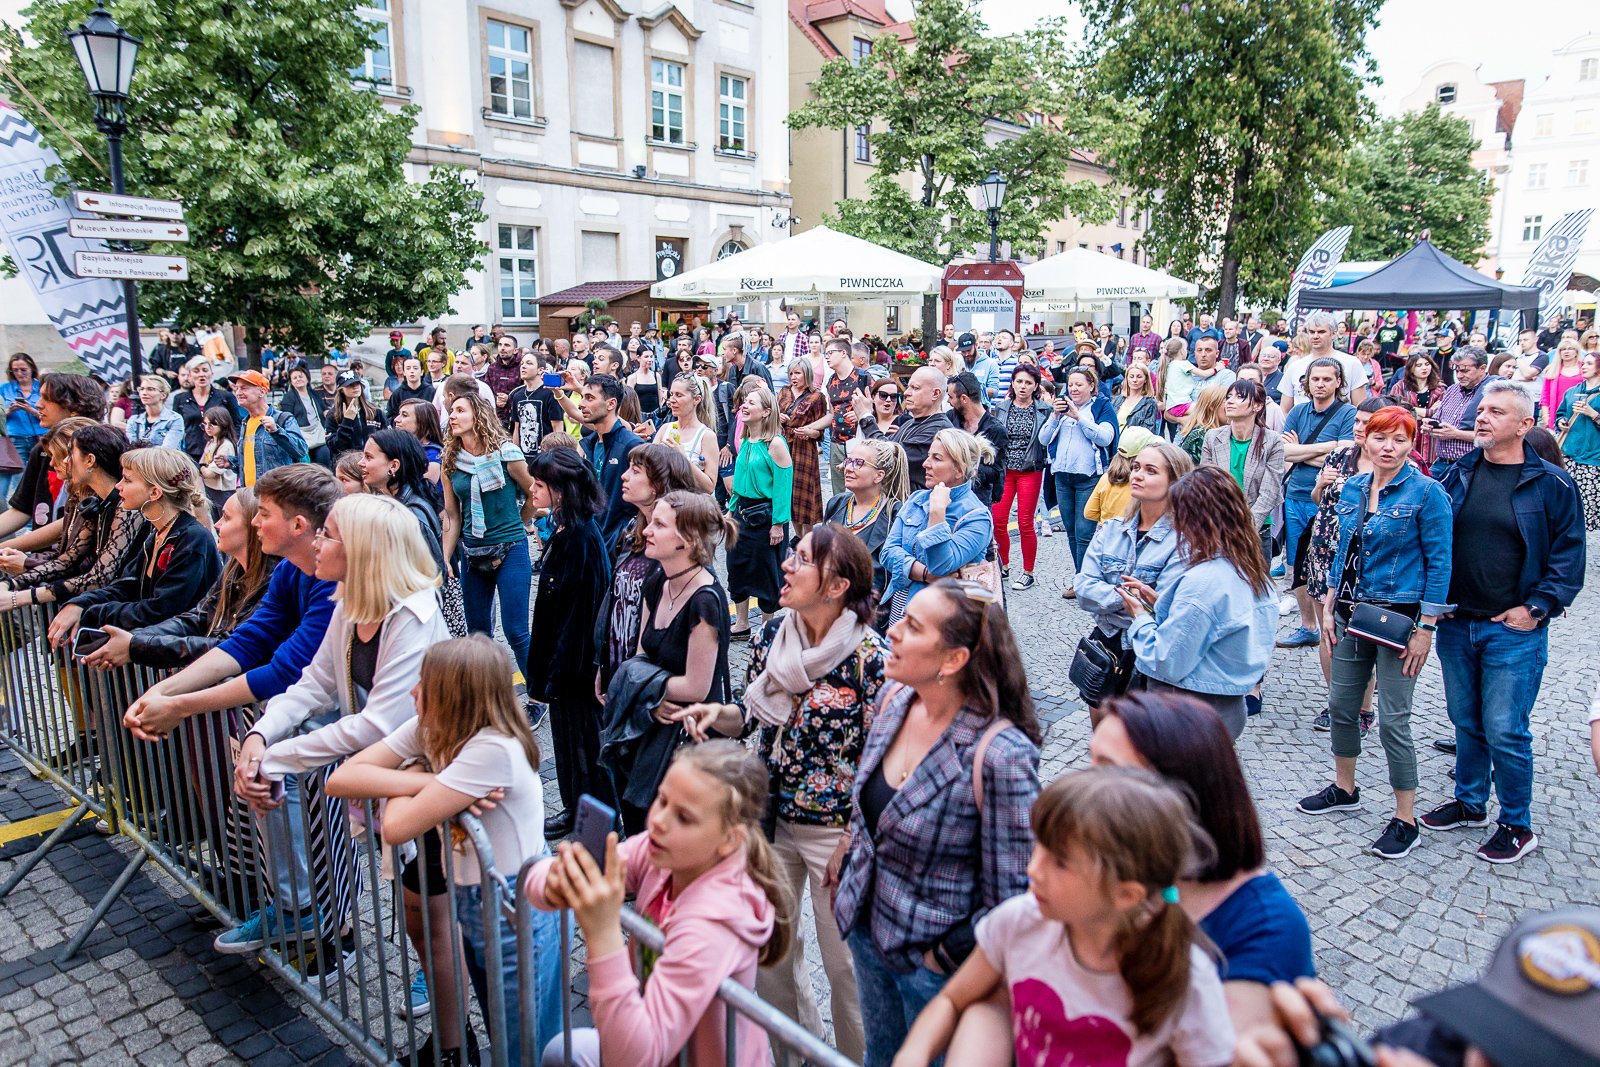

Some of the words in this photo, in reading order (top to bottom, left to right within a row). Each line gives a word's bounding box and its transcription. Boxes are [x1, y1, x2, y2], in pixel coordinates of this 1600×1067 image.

[109, 201, 143, 211] Informacja
[144, 204, 178, 214] Turystyczna
[77, 224, 107, 232] Muzeum
[110, 225, 153, 234] Karkonoskie
[81, 254, 111, 263] Bazylika
[114, 256, 143, 264] Mniejsza
[129, 269, 168, 278] Pankracego
[740, 278, 773, 290] Kozel
[840, 278, 904, 288] PIWNICZKA
[1096, 287, 1147, 295] PIWNICZKA
[1048, 303, 1071, 311] Kozel
